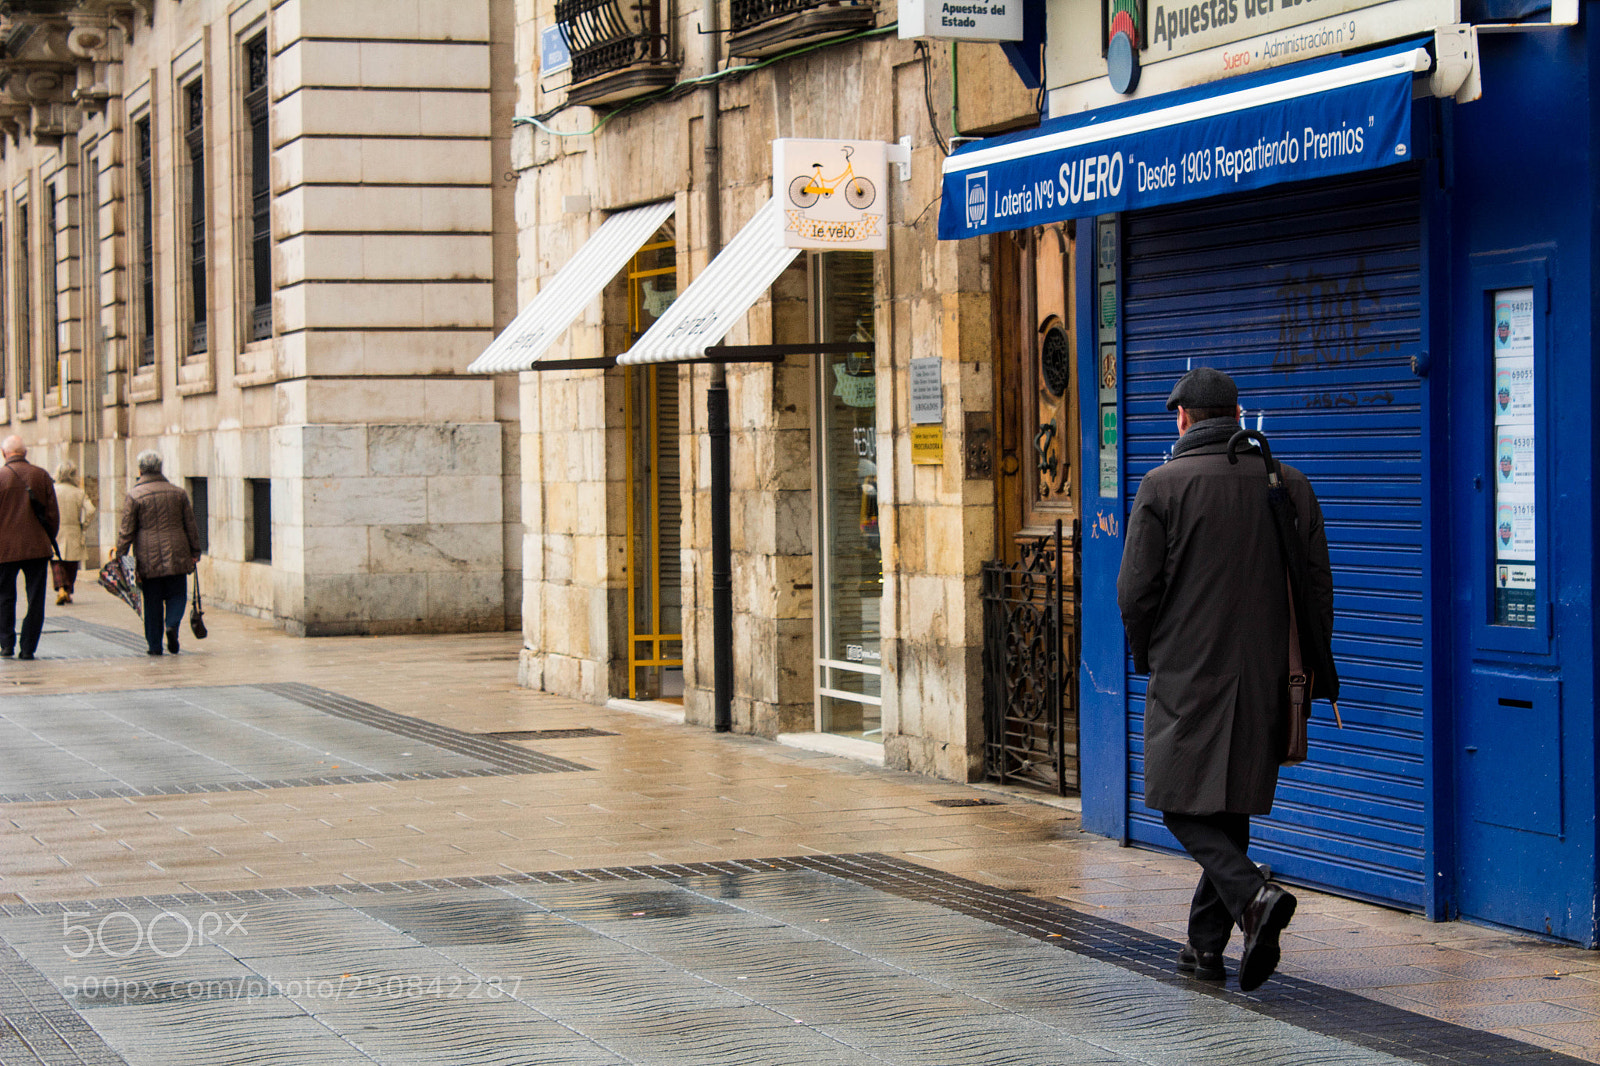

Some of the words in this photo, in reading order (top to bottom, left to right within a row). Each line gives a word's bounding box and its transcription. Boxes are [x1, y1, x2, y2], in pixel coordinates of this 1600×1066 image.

[942, 3, 988, 16] Apuestas
[991, 5, 1006, 16] del
[942, 17, 976, 28] Estado
[1154, 0, 1239, 51] Apuestas
[1223, 51, 1251, 71] Suero
[1263, 26, 1335, 60] Administración
[1349, 20, 1356, 41] 9
[994, 184, 1032, 218] Lotería
[1057, 151, 1124, 207] SUERO
[1138, 157, 1176, 192] Desde
[1180, 149, 1211, 184] 1903
[1215, 131, 1299, 183] Repartiendo
[1304, 121, 1364, 161] Premios
[812, 224, 825, 238] le
[1511, 301, 1533, 312] 54023
[1512, 369, 1533, 379] 69055
[1513, 437, 1535, 448] 45307
[1513, 504, 1535, 515] 31618
